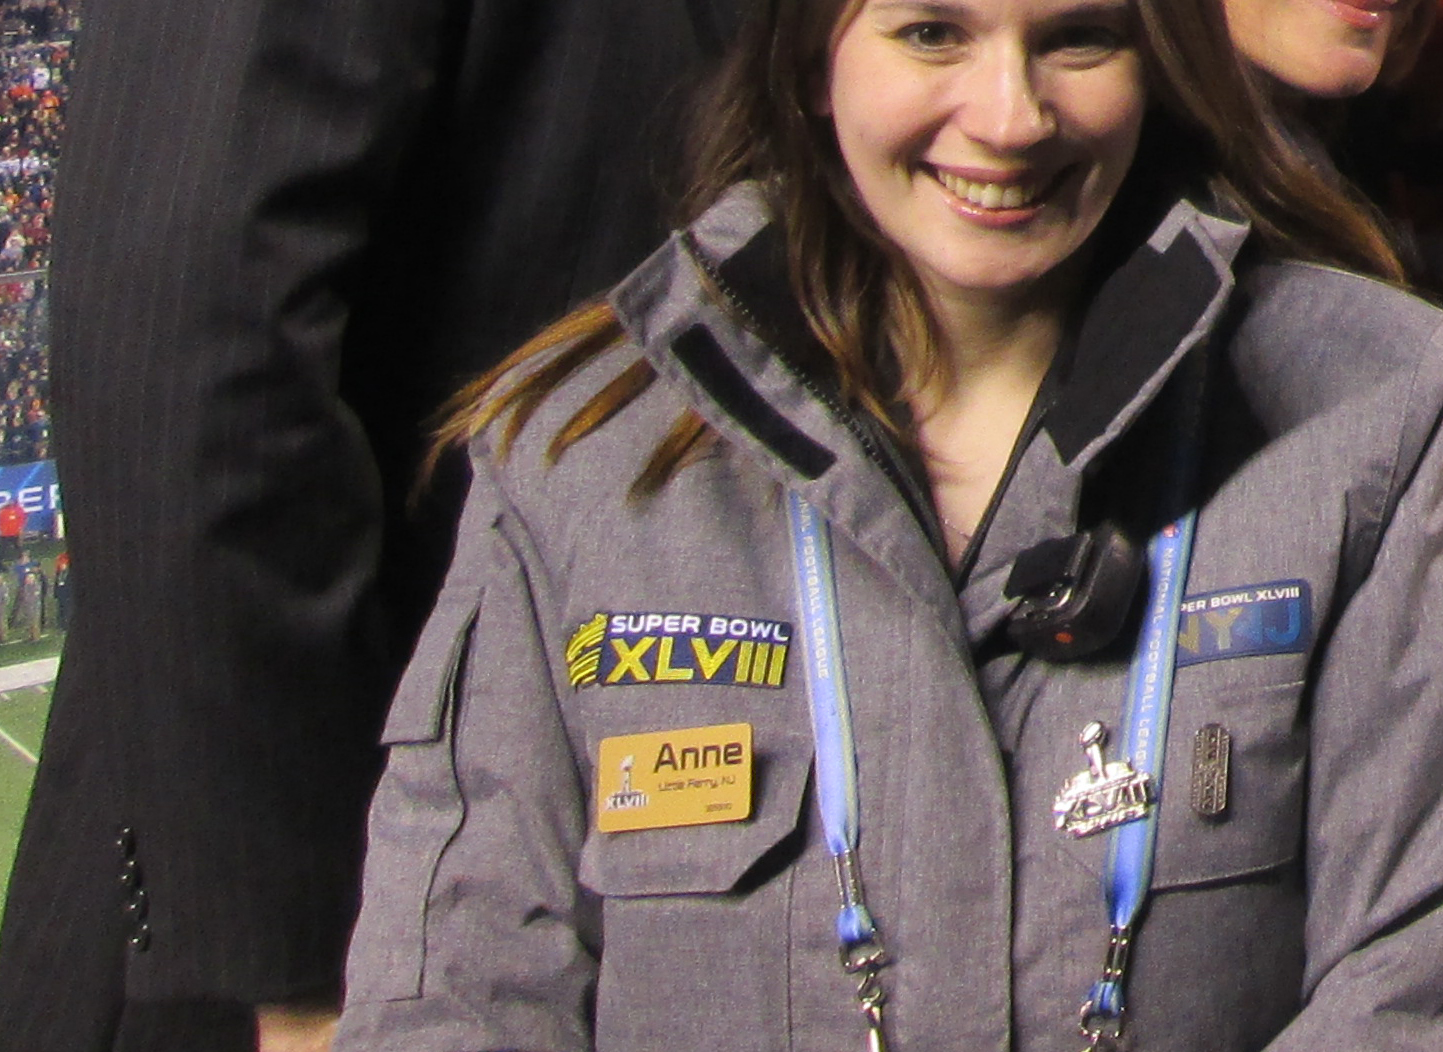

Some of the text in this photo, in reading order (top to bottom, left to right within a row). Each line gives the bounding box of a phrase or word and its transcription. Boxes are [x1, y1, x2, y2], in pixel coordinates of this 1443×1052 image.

[803, 535, 822, 616] FOOTBALL
[1152, 547, 1175, 624] NATIONAL
[1211, 593, 1253, 608] BOWL
[1256, 586, 1300, 602] XLVIII
[611, 614, 790, 642] SUPER BOWL
[812, 618, 830, 680] LEAGUE
[604, 636, 788, 686] XLVIII
[1140, 629, 1164, 712] FOOTBALL
[653, 742, 744, 774] Anne
[604, 793, 650, 810] XLVIII
